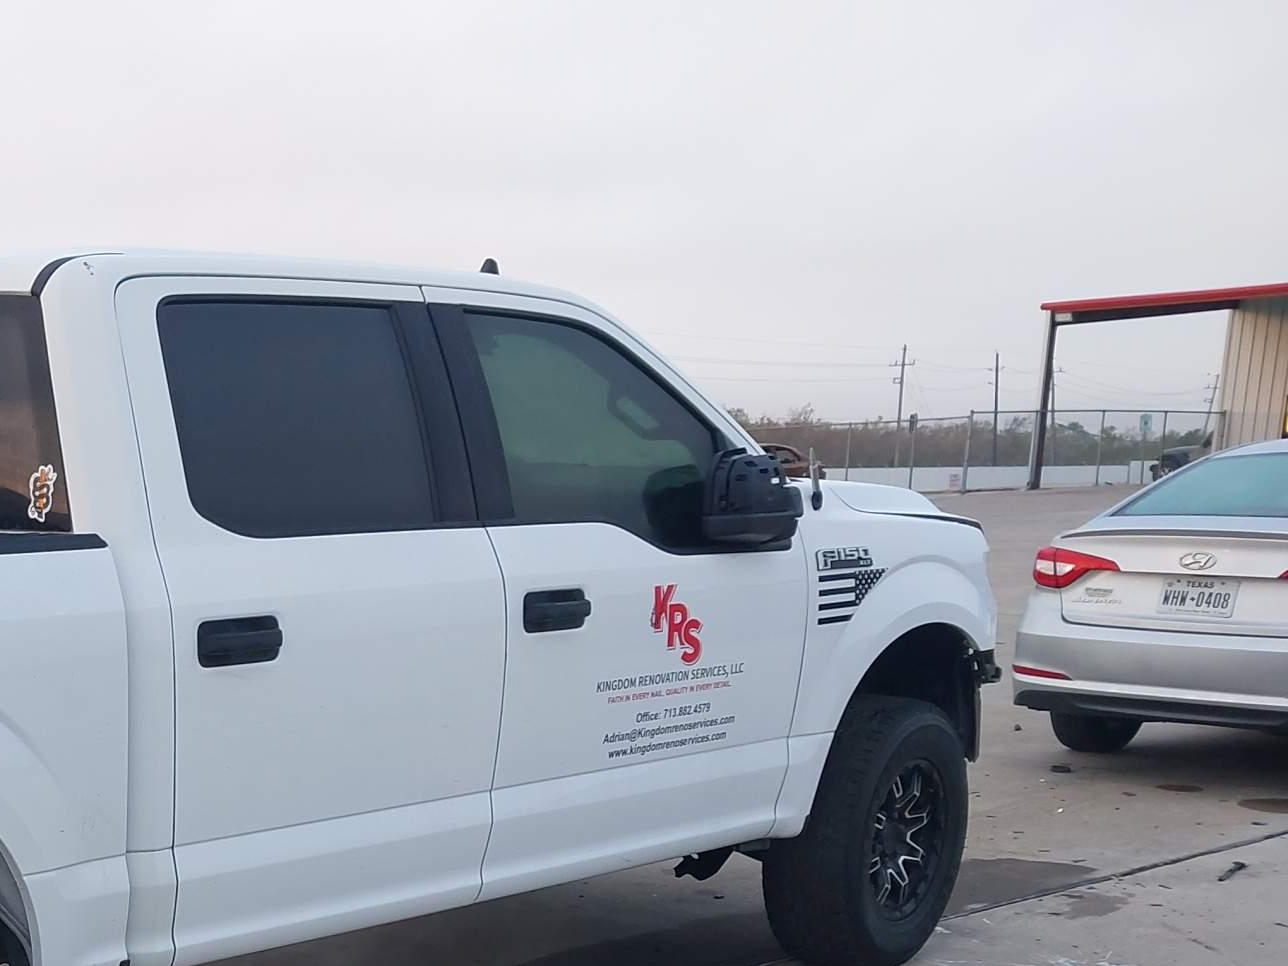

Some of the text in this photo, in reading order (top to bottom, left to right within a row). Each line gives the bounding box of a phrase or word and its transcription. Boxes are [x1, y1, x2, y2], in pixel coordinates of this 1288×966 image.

[1186, 580, 1216, 589] TEXAS
[651, 583, 703, 666] KRS
[596, 662, 745, 693] KINGDOM RENOVATION SERVICES, LLC
[607, 696, 624, 704] FAITH
[631, 692, 650, 700] EVERY
[665, 686, 688, 696] QUALITY
[695, 683, 713, 692] EVERY
[635, 702, 711, 723] Office: 713.882.4579
[602, 715, 735, 745] Adrian@Kingdomrenoservices.com
[608, 731, 727, 759] www.kingdomrenoservices.com
